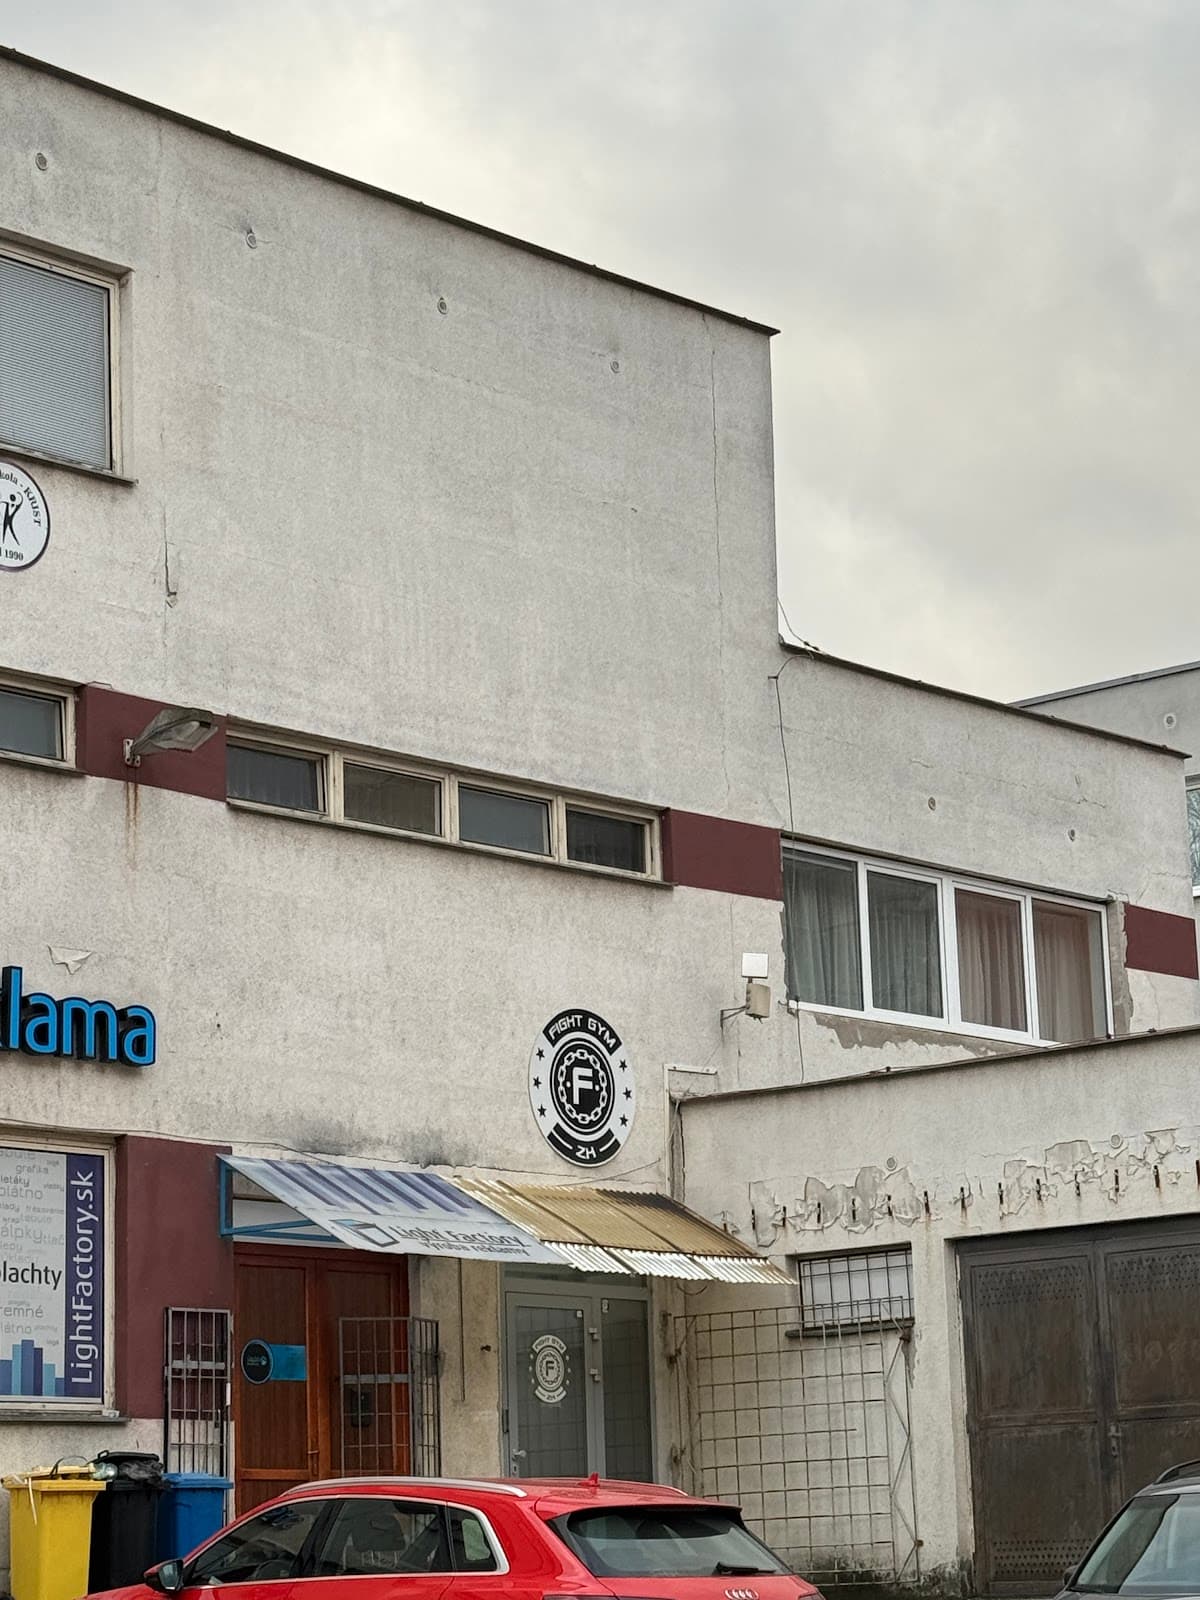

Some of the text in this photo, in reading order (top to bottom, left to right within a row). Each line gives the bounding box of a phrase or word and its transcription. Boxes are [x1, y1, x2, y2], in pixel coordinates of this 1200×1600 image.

[5, 549, 24, 561] 1990
[0, 965, 156, 1067] lama
[548, 1014, 618, 1049] FIGHT GYM
[572, 1066, 594, 1105] F
[575, 1144, 597, 1160] ZH
[388, 1225, 532, 1248] Light Factory
[0, 1261, 62, 1290] lachty
[69, 1171, 98, 1382] LightFactory.sk
